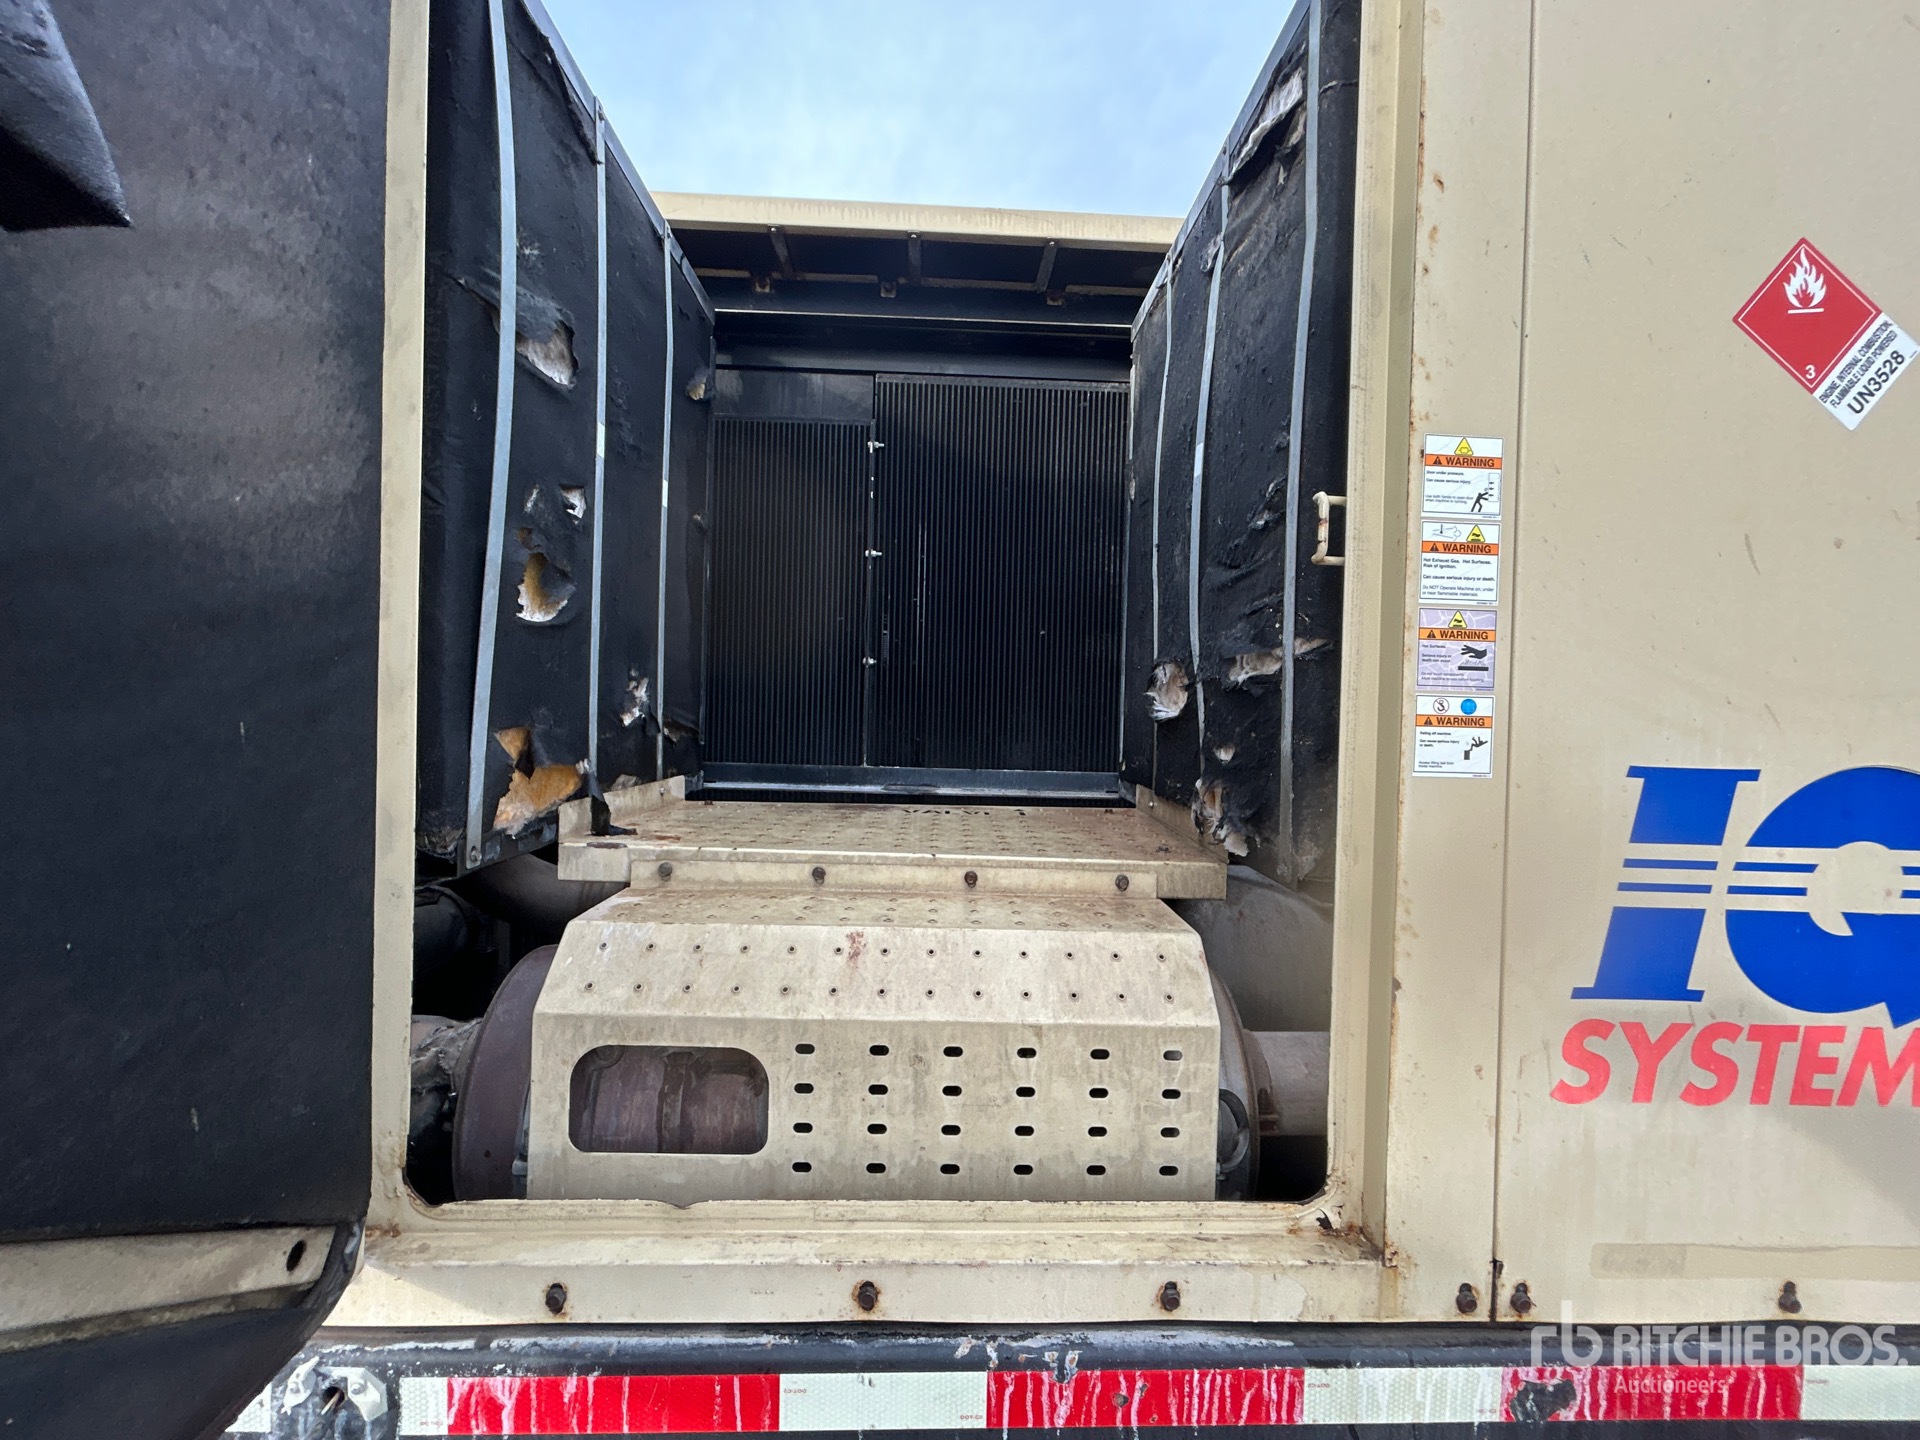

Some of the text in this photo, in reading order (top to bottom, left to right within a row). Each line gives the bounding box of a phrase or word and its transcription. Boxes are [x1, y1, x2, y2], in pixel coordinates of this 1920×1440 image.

[1805, 364, 1816, 380] 3
[1830, 330, 1898, 408] FLAMMABLE LIQUID POWERED
[1836, 355, 1862, 383] INTERNAL
[1846, 350, 1905, 414] UN3528
[1445, 456, 1495, 468] WARNING
[1442, 543, 1492, 554] WARNING
[1439, 630, 1489, 640] WARNING
[1436, 716, 1486, 727] WARNING
[1550, 1018, 1920, 1107] SYSTEM
